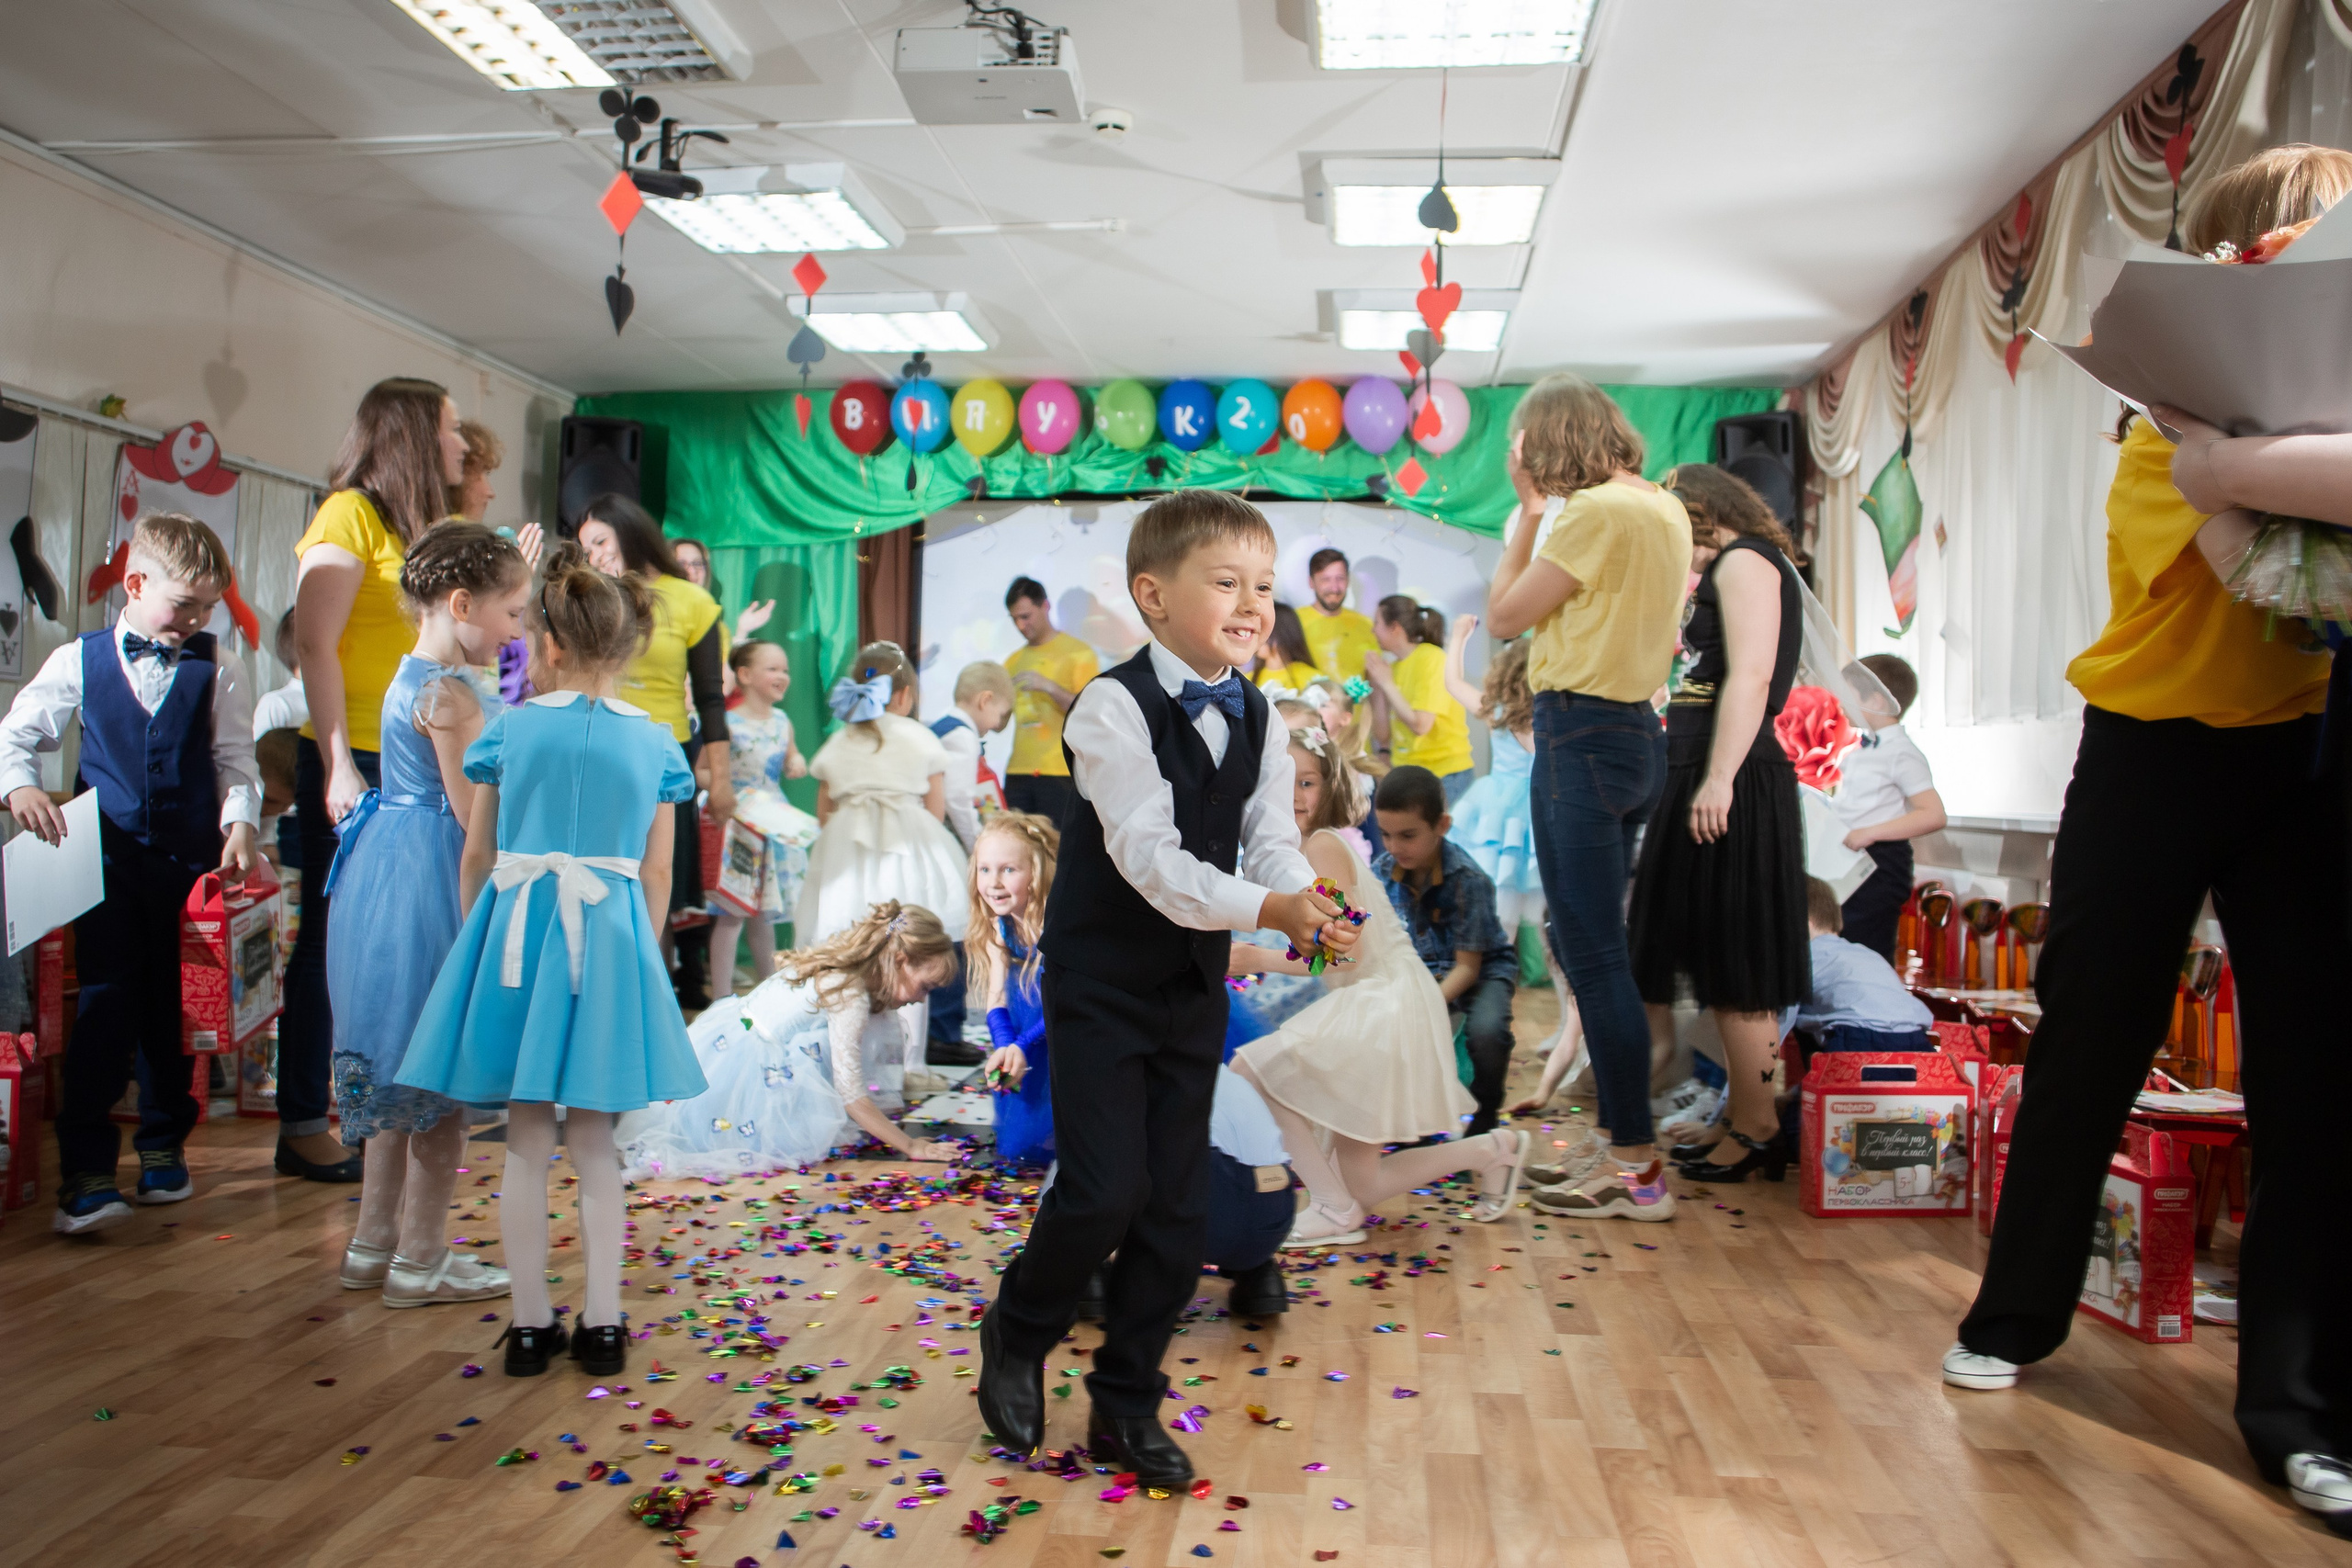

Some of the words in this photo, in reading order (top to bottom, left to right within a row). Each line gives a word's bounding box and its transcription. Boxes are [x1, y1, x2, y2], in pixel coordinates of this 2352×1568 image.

[122, 469, 141, 493] A
[1866, 1128, 1908, 1148] Первый
[1908, 1134, 1928, 1148] раз
[1870, 1143, 1901, 1160] первый
[1902, 1145, 1933, 1157] класс!
[1827, 1185, 1871, 1196] НАБОР
[1827, 1198, 1915, 1206] ПЕРВОКЛАССНИКА
